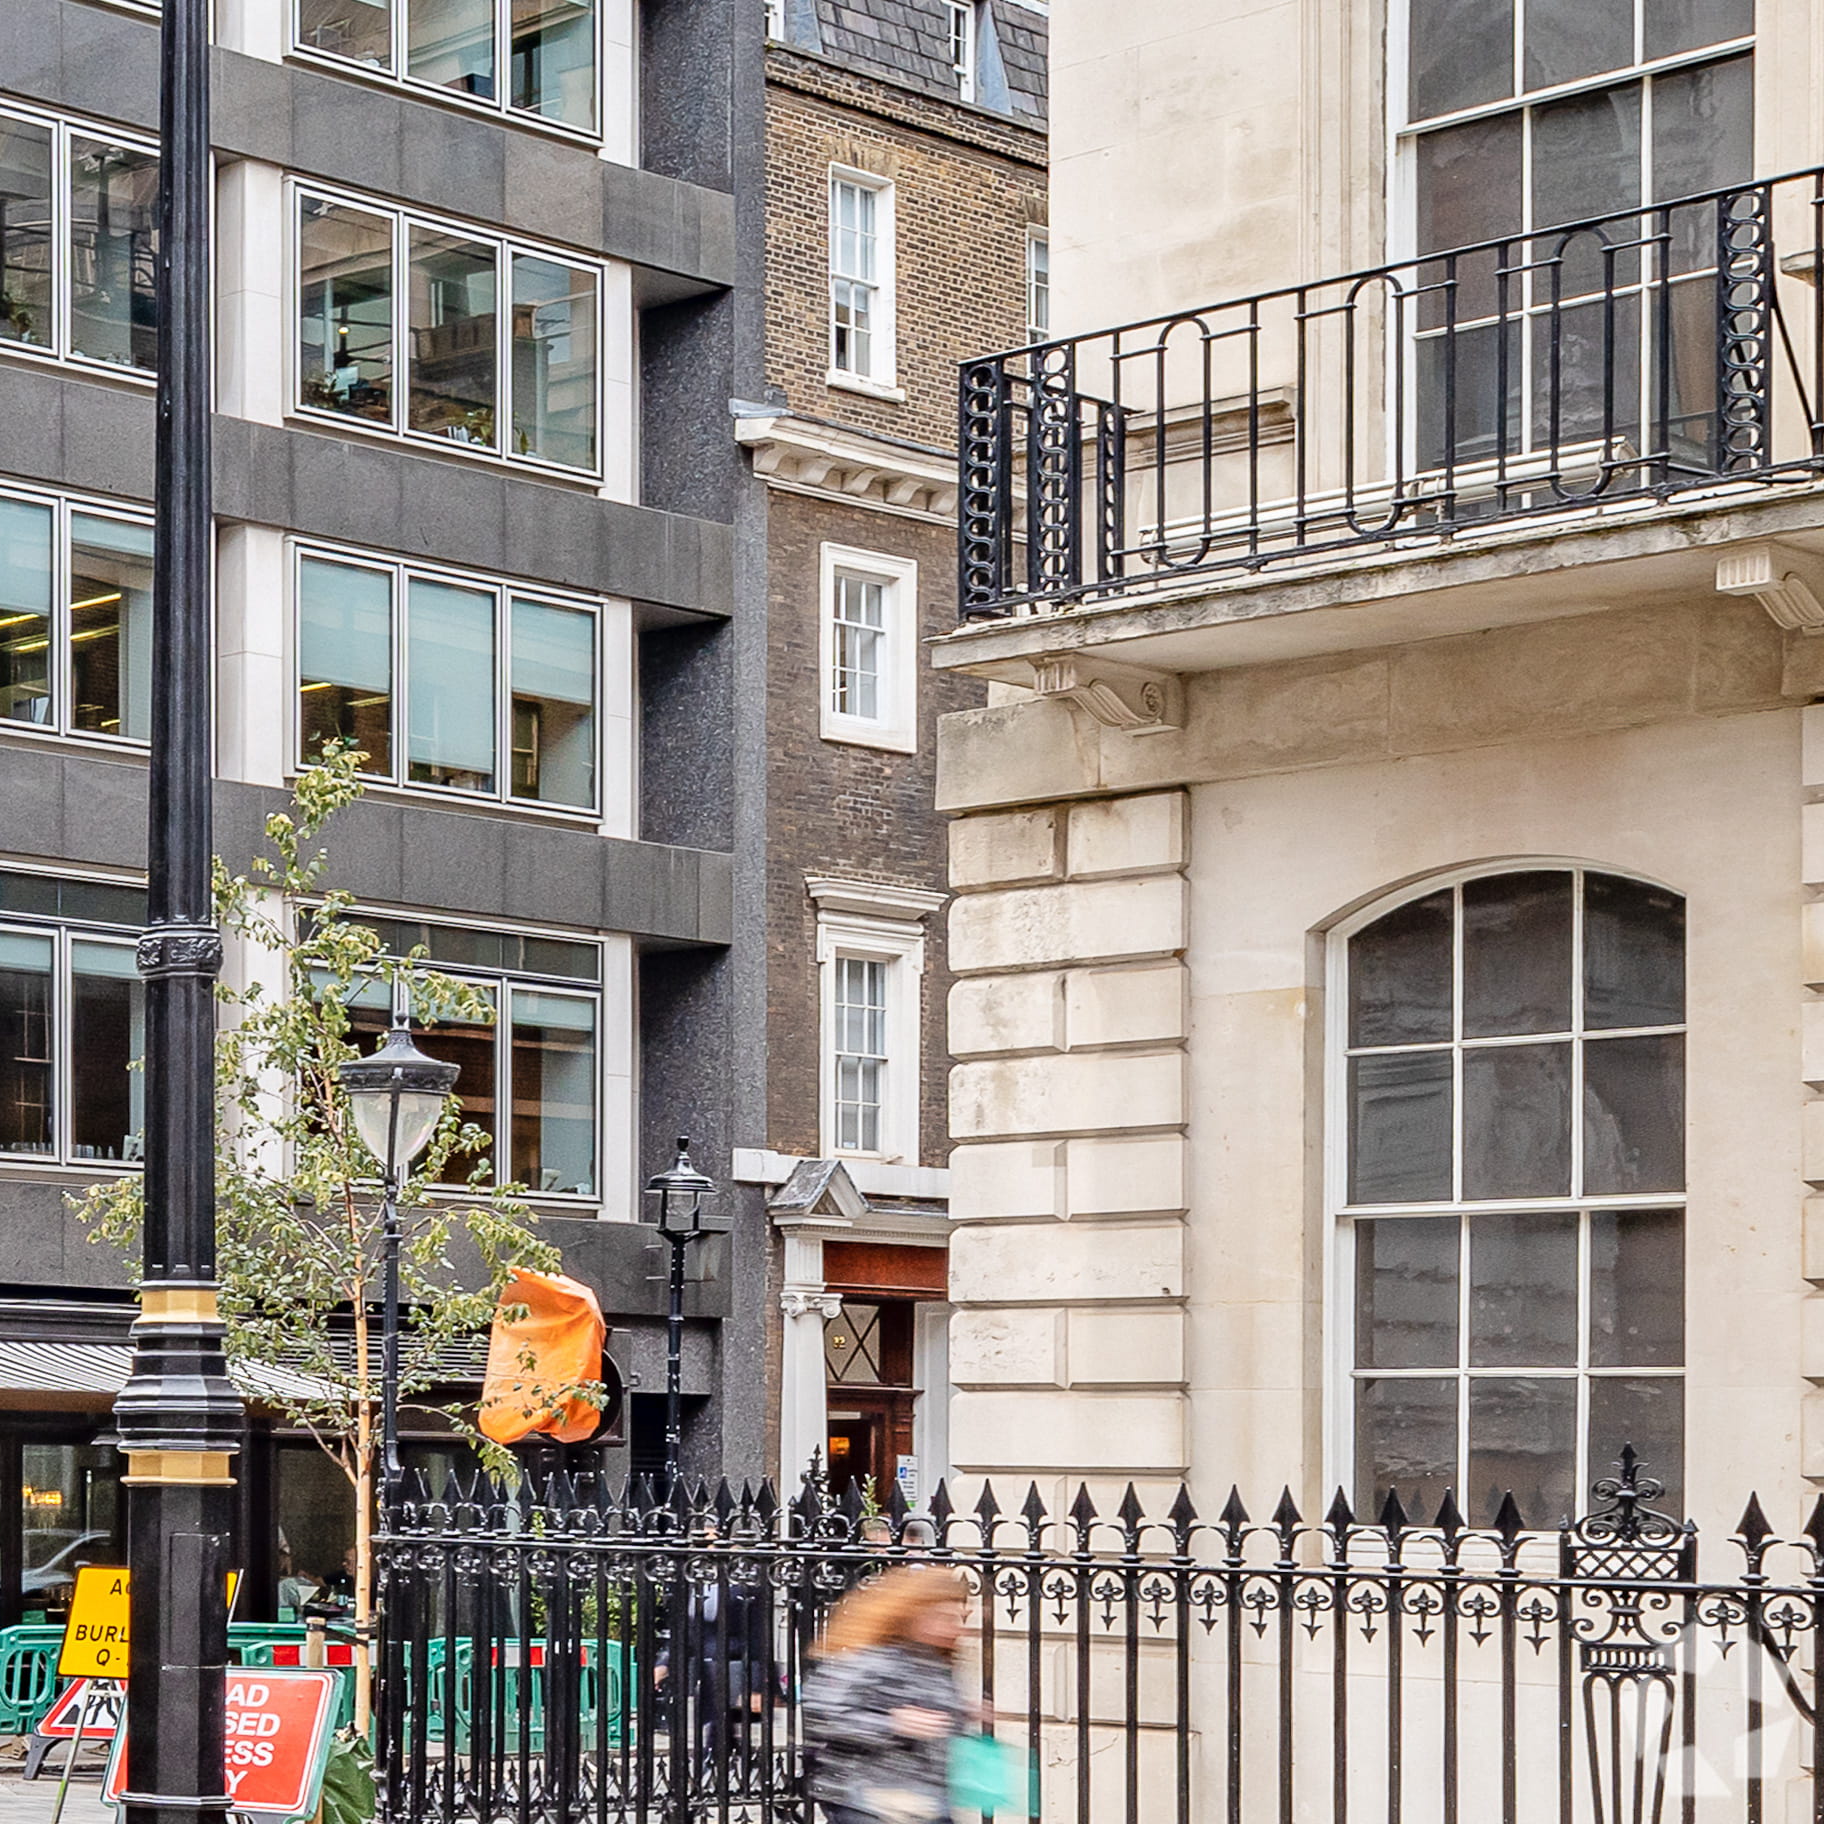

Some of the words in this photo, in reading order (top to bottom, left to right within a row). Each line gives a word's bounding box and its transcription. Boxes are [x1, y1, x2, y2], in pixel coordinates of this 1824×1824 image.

[75, 1624, 129, 1643] BURL
[225, 1683, 271, 1708] AD
[225, 1711, 281, 1737] SED
[225, 1740, 275, 1767] ESS
